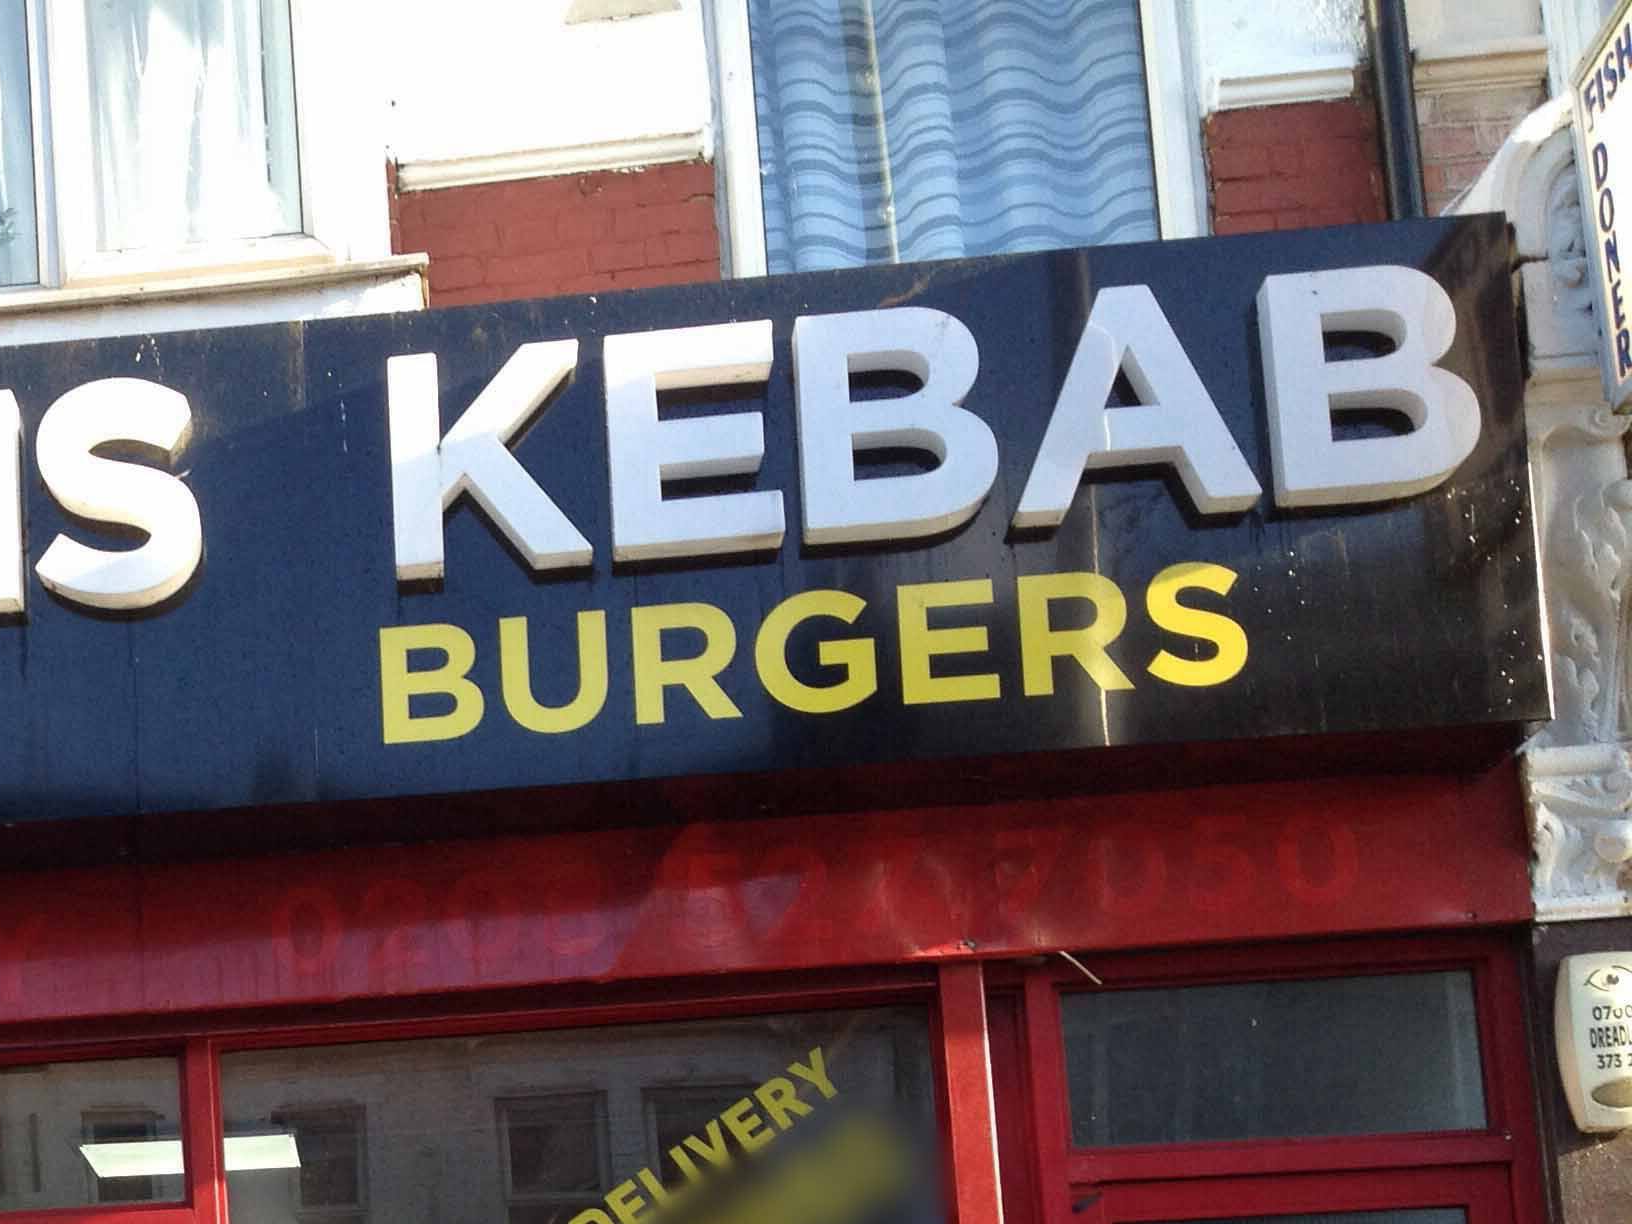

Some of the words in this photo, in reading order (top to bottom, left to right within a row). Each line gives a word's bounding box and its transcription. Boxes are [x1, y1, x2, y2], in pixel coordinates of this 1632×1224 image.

[1592, 142, 1632, 378] DONER
[386, 264, 1483, 582] KEBAB
[378, 562, 1250, 745] BURGERS
